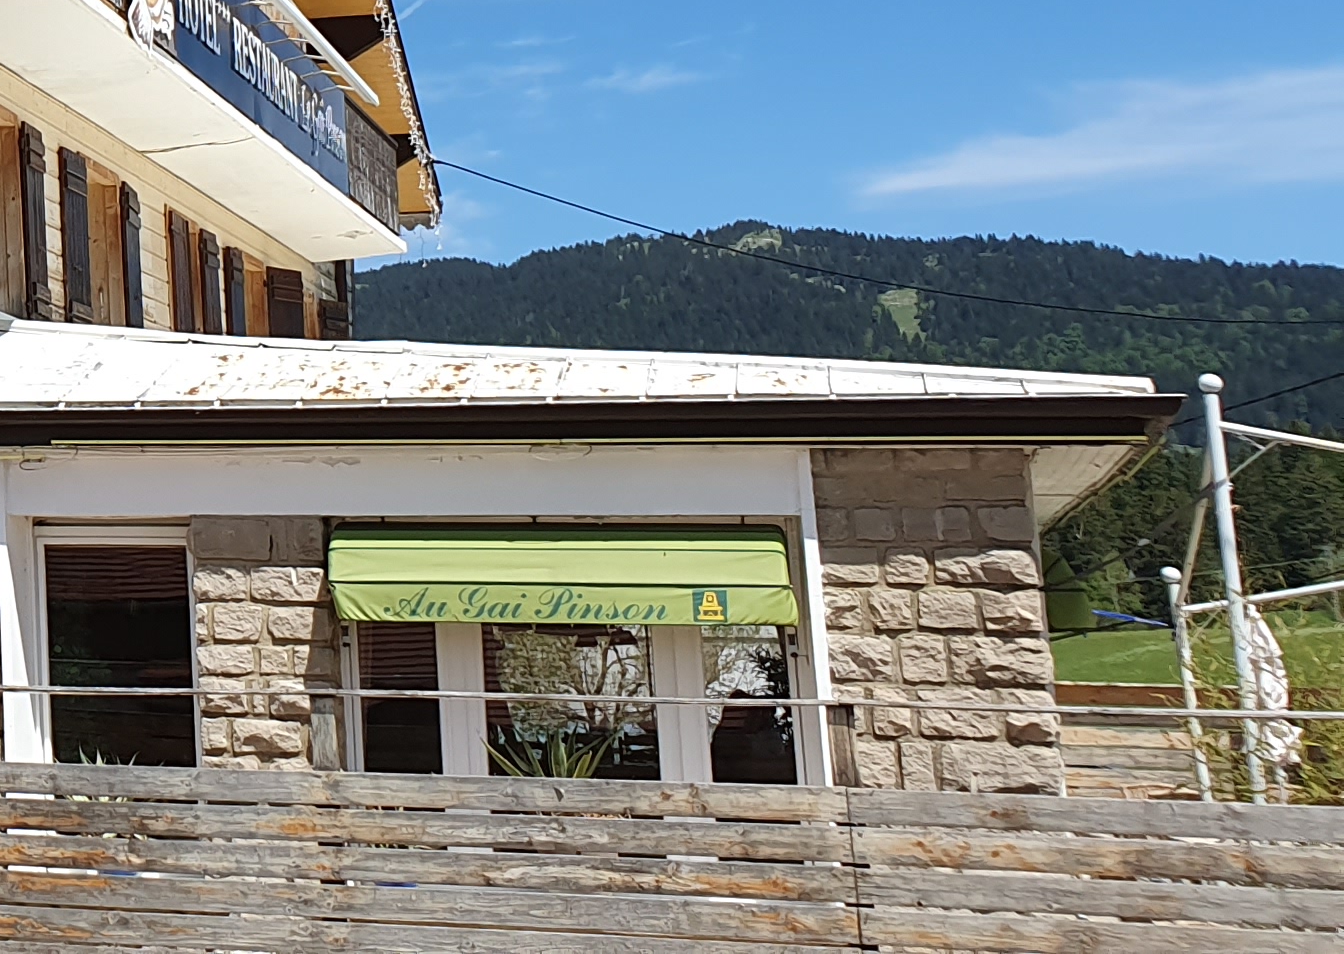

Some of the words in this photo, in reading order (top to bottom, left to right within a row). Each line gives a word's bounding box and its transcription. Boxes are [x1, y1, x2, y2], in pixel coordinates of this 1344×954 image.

[232, 16, 299, 124] RESTAURANT
[382, 586, 448, 618] Au
[457, 586, 529, 620] Gai
[533, 586, 670, 621] Pinson
